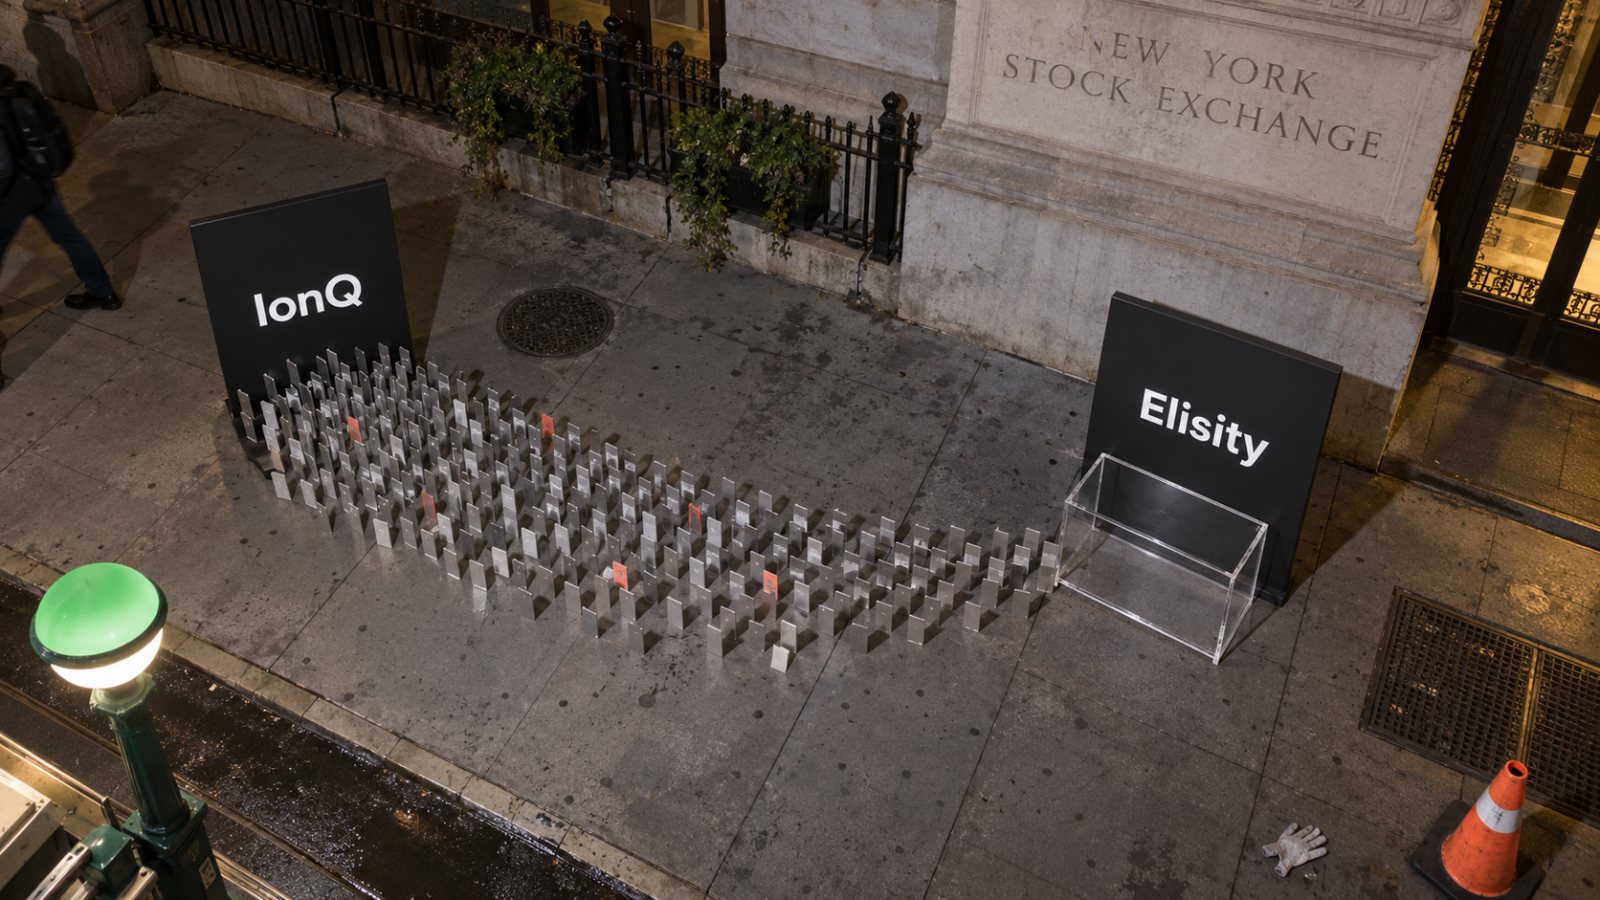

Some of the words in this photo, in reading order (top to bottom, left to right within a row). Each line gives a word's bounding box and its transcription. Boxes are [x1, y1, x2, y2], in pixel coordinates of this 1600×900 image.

[1003, 54, 1131, 103] STOCK
[1079, 26, 1170, 66] NEW
[1204, 50, 1318, 99] YORK
[254, 273, 363, 327] IonQ
[1140, 388, 1270, 468] Elisity
